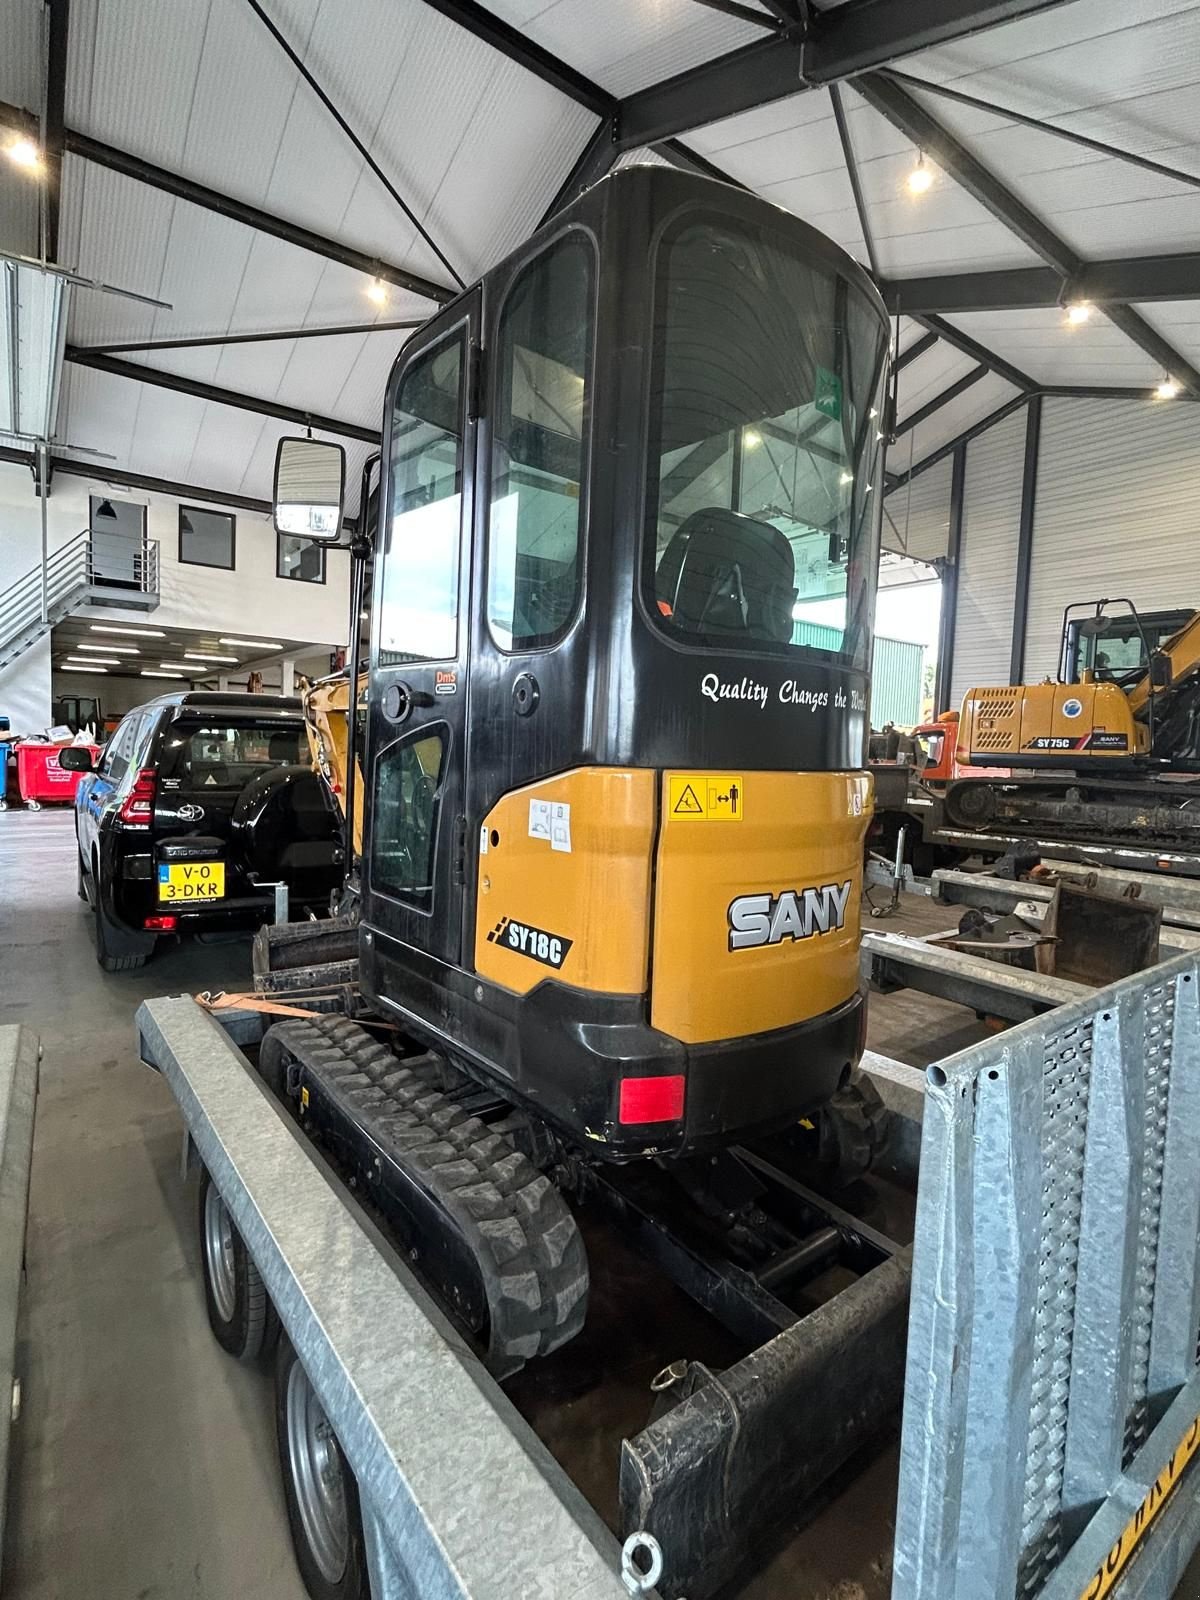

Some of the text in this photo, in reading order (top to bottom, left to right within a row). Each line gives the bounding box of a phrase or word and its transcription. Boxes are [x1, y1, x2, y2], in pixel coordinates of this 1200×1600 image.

[701, 673, 769, 709] Quality
[779, 680, 828, 712] Changes
[834, 687, 847, 708] the
[167, 883, 217, 898] 3-DKR
[728, 879, 852, 952] SANY
[508, 922, 562, 964] SY18C
